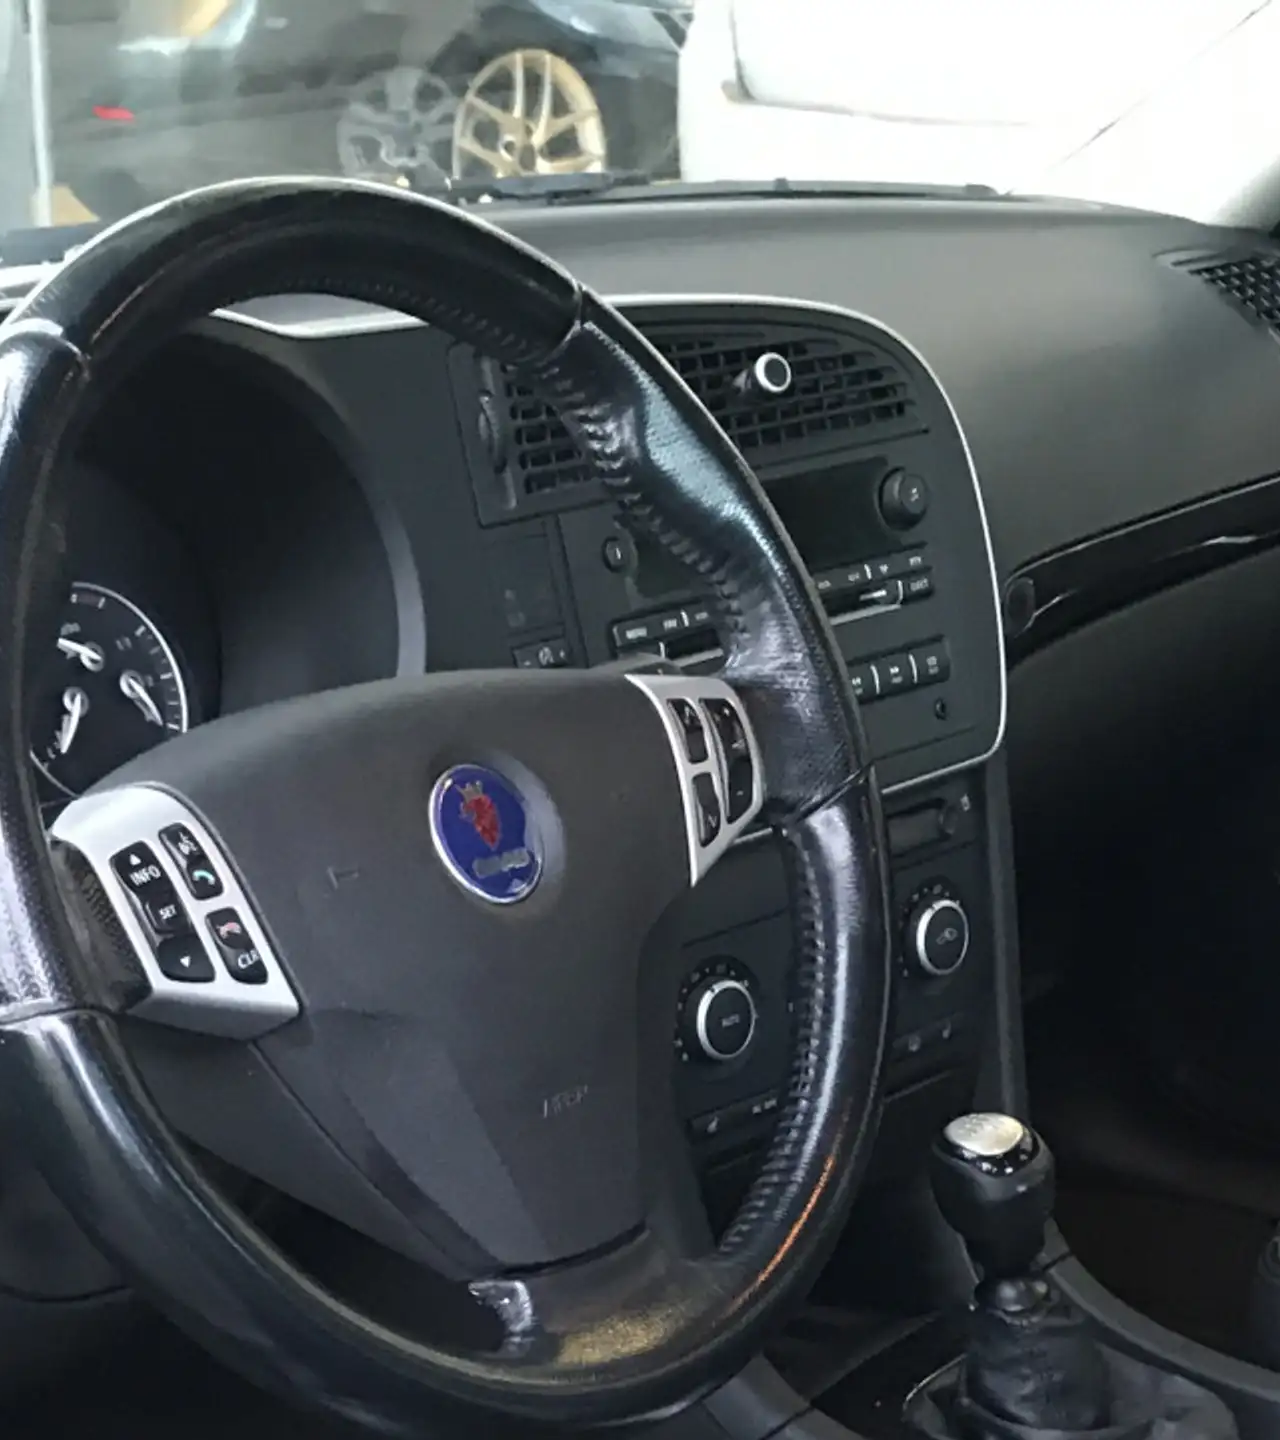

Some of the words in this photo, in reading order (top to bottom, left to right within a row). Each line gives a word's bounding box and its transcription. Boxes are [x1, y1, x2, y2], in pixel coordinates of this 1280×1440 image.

[130, 865, 161, 886] INFO
[159, 904, 177, 920] SET
[238, 950, 260, 969] CLR
